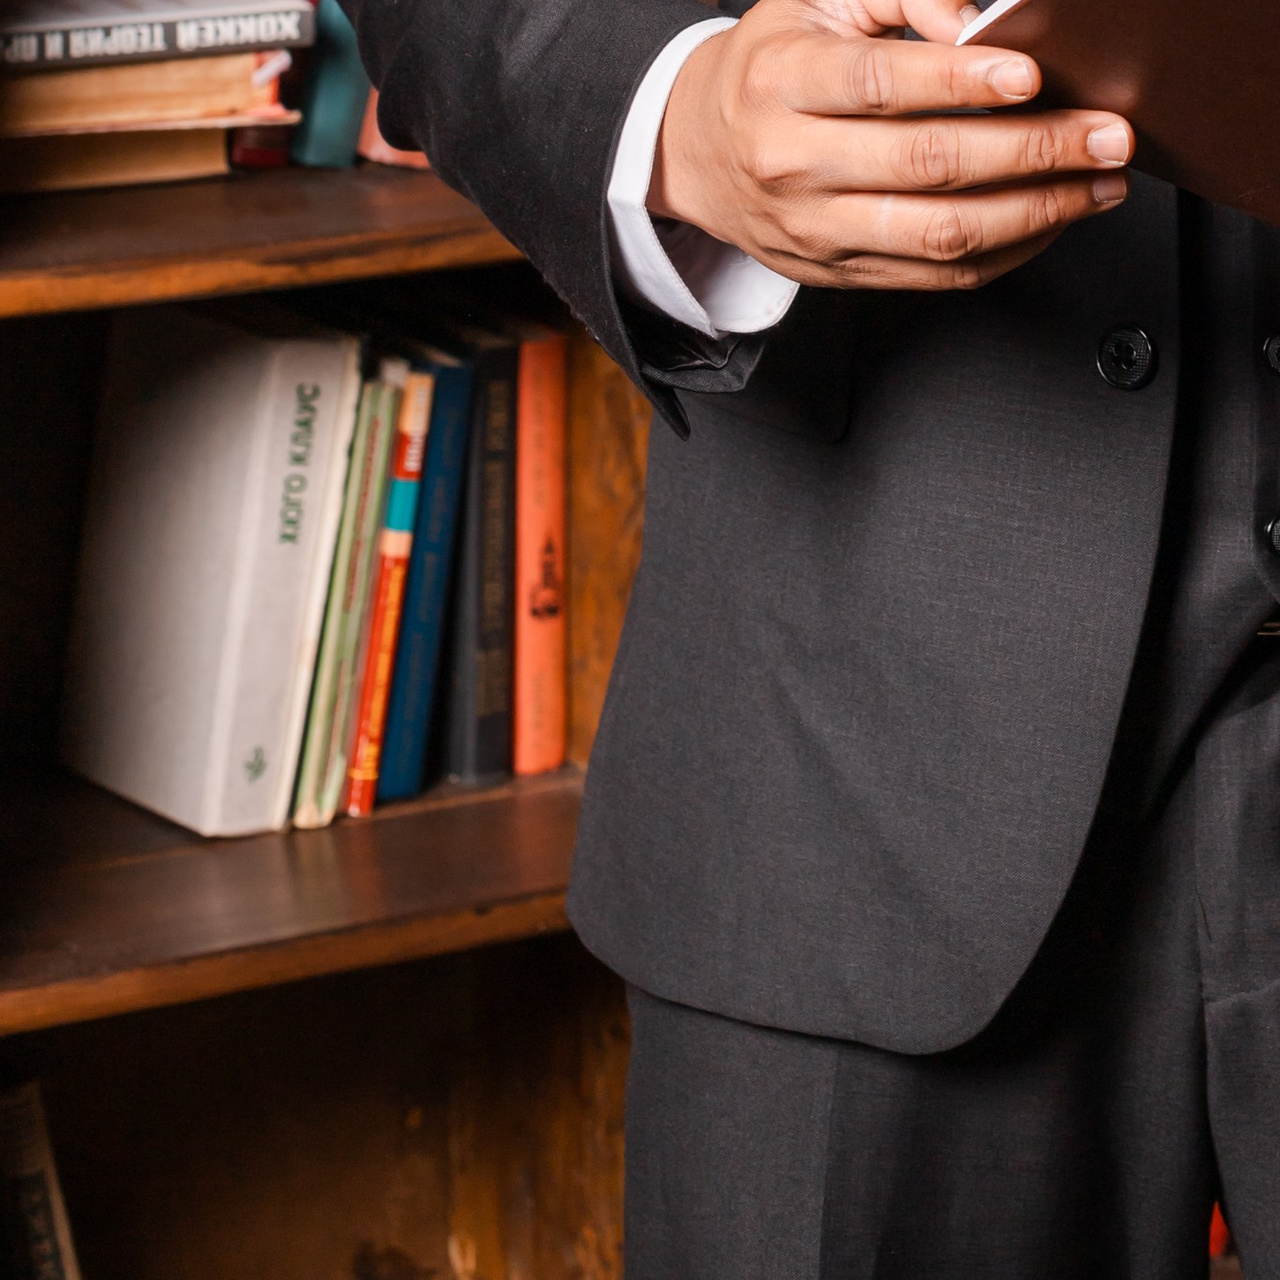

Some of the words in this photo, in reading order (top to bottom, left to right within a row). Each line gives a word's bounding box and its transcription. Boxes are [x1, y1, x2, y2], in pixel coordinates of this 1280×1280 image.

[1, 34, 39, 64] ПР
[44, 32, 65, 60] И
[68, 22, 166, 58] ТЕОРИЯ
[176, 11, 301, 51] ХОККЕЙ
[289, 382, 321, 466] КЛАУС
